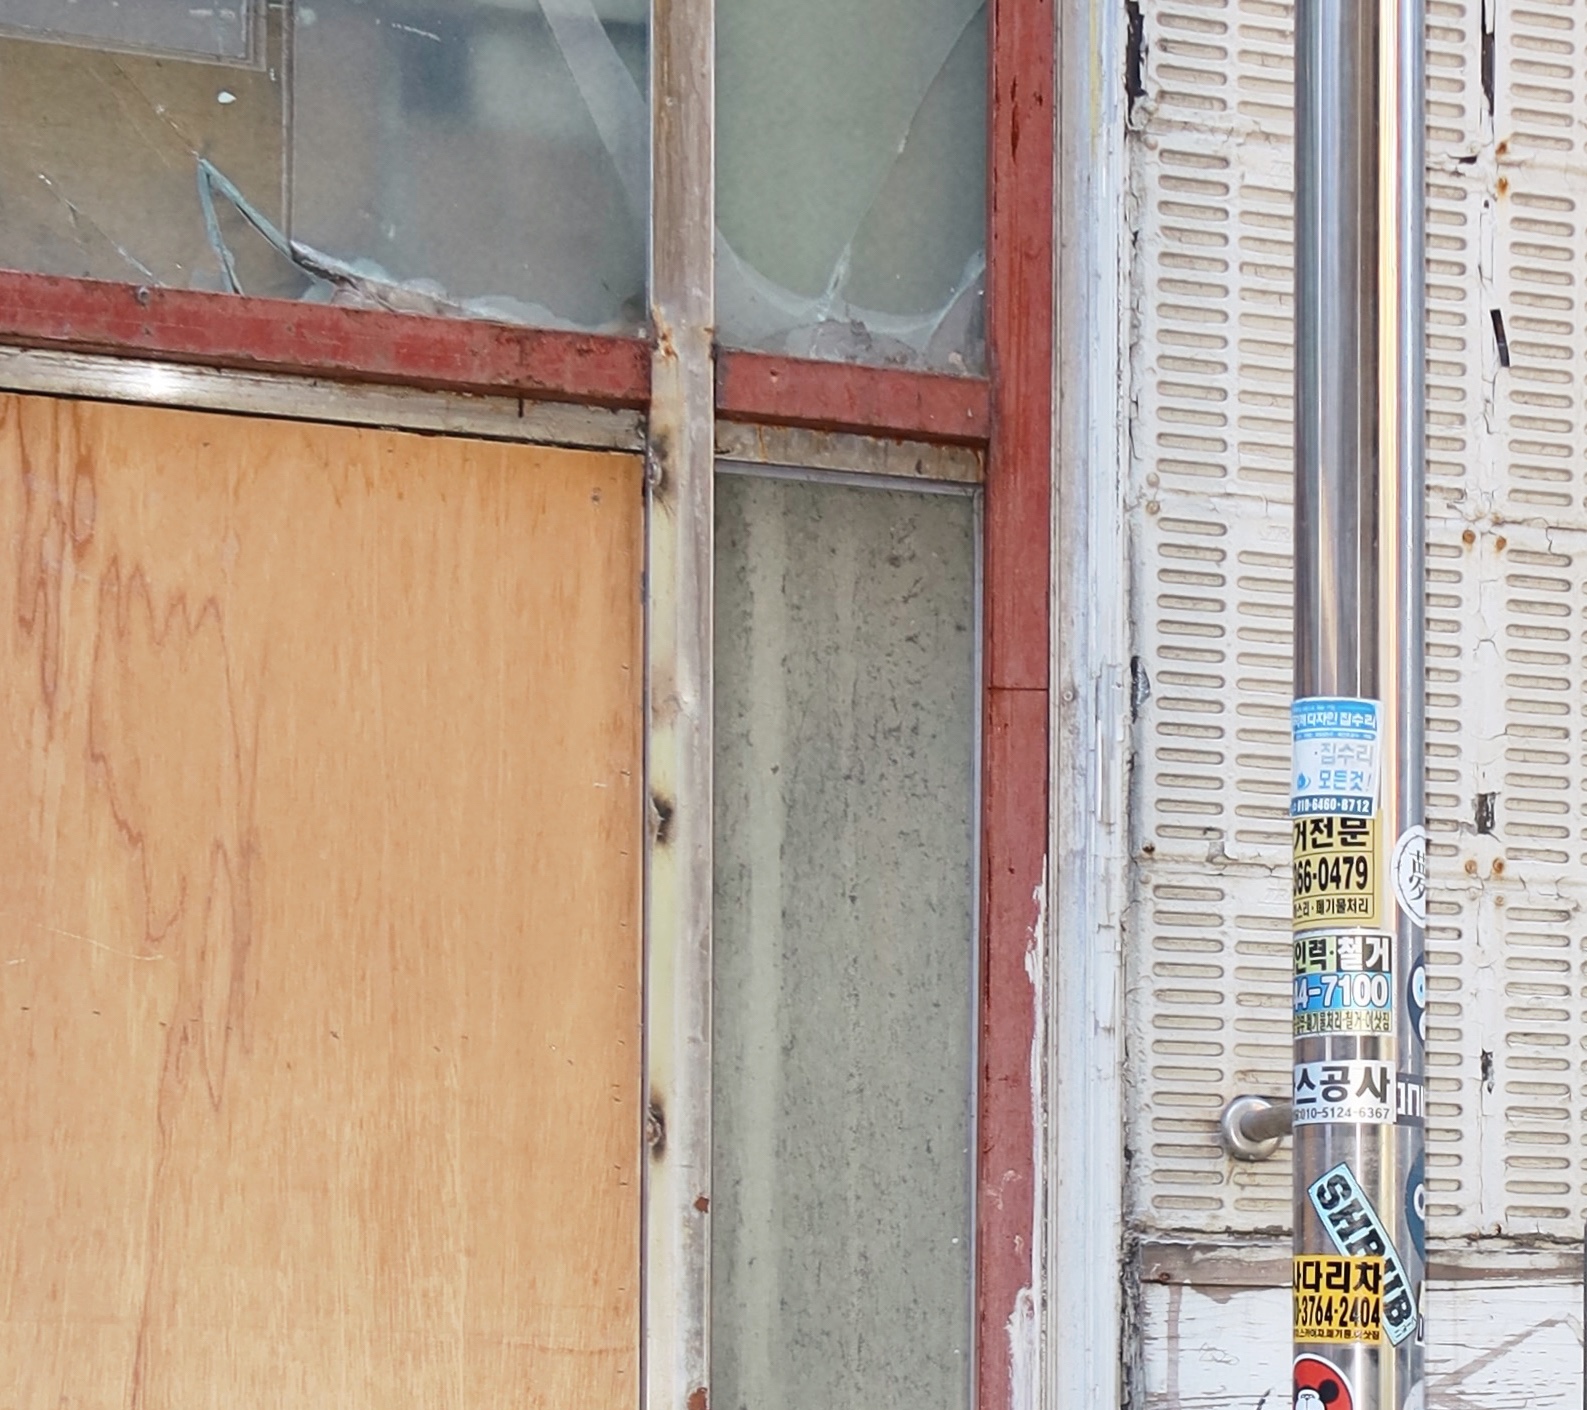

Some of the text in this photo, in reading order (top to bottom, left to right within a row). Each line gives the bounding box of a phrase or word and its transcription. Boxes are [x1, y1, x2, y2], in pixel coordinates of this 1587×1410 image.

[1340, 712, 1376, 728] 집수리
[1321, 743, 1373, 767] 집수리
[1293, 1065, 1391, 1104] 스공사
